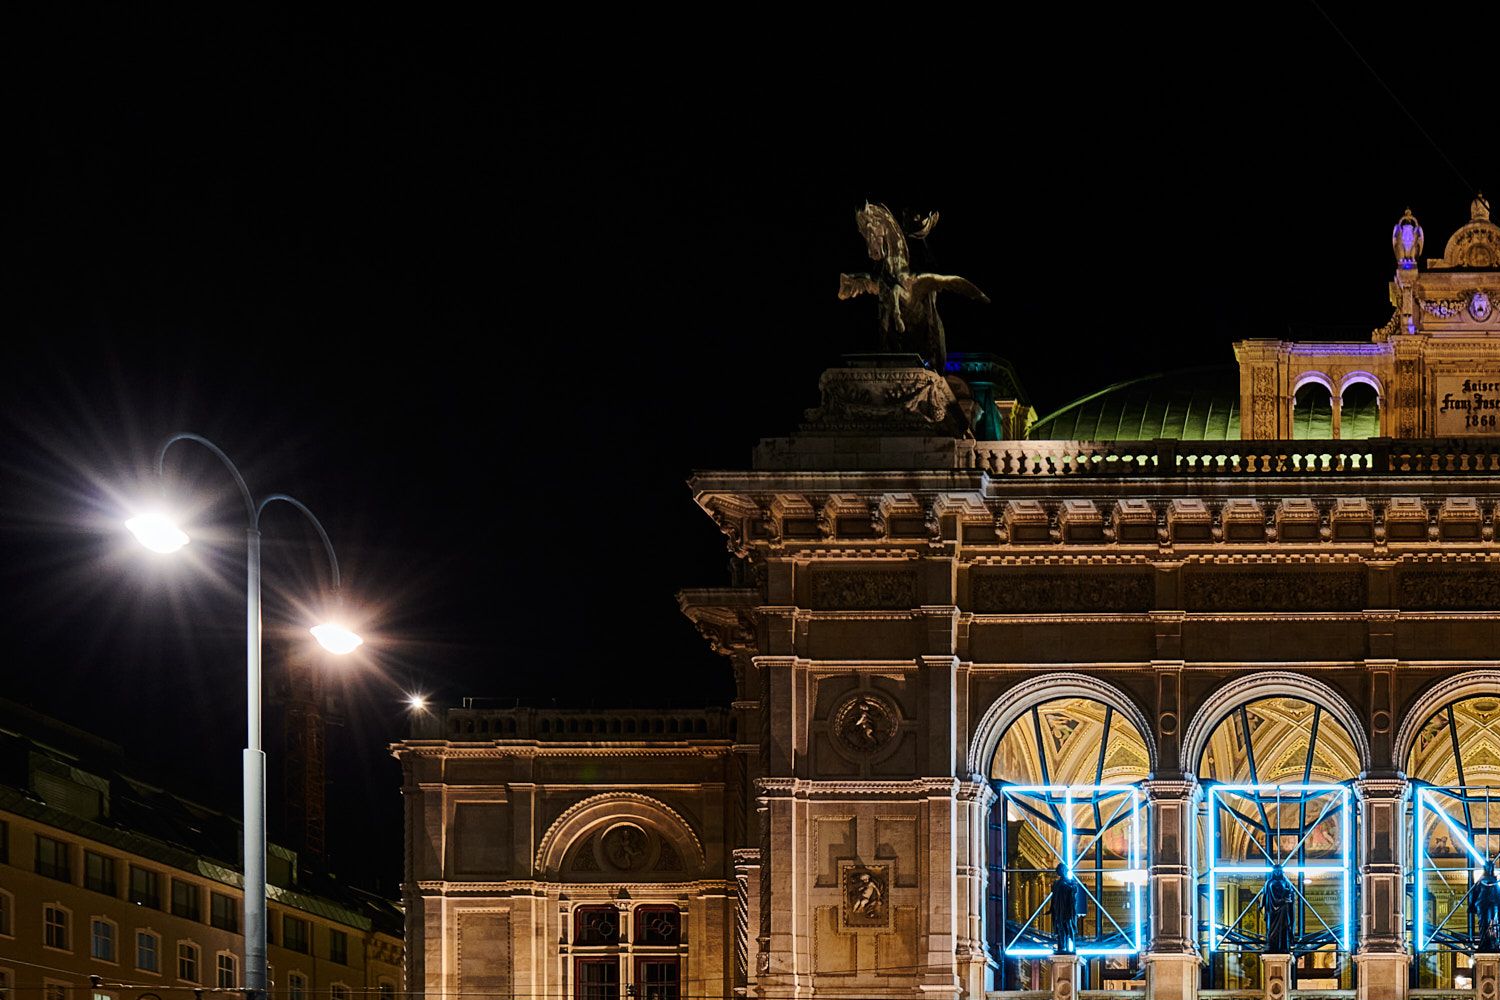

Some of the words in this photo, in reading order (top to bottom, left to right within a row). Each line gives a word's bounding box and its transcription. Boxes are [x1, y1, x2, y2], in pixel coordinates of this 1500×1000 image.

[1462, 379, 1500, 393] Kaiser
[1440, 393, 1471, 414] Franz
[1465, 415, 1496, 428] 1868
